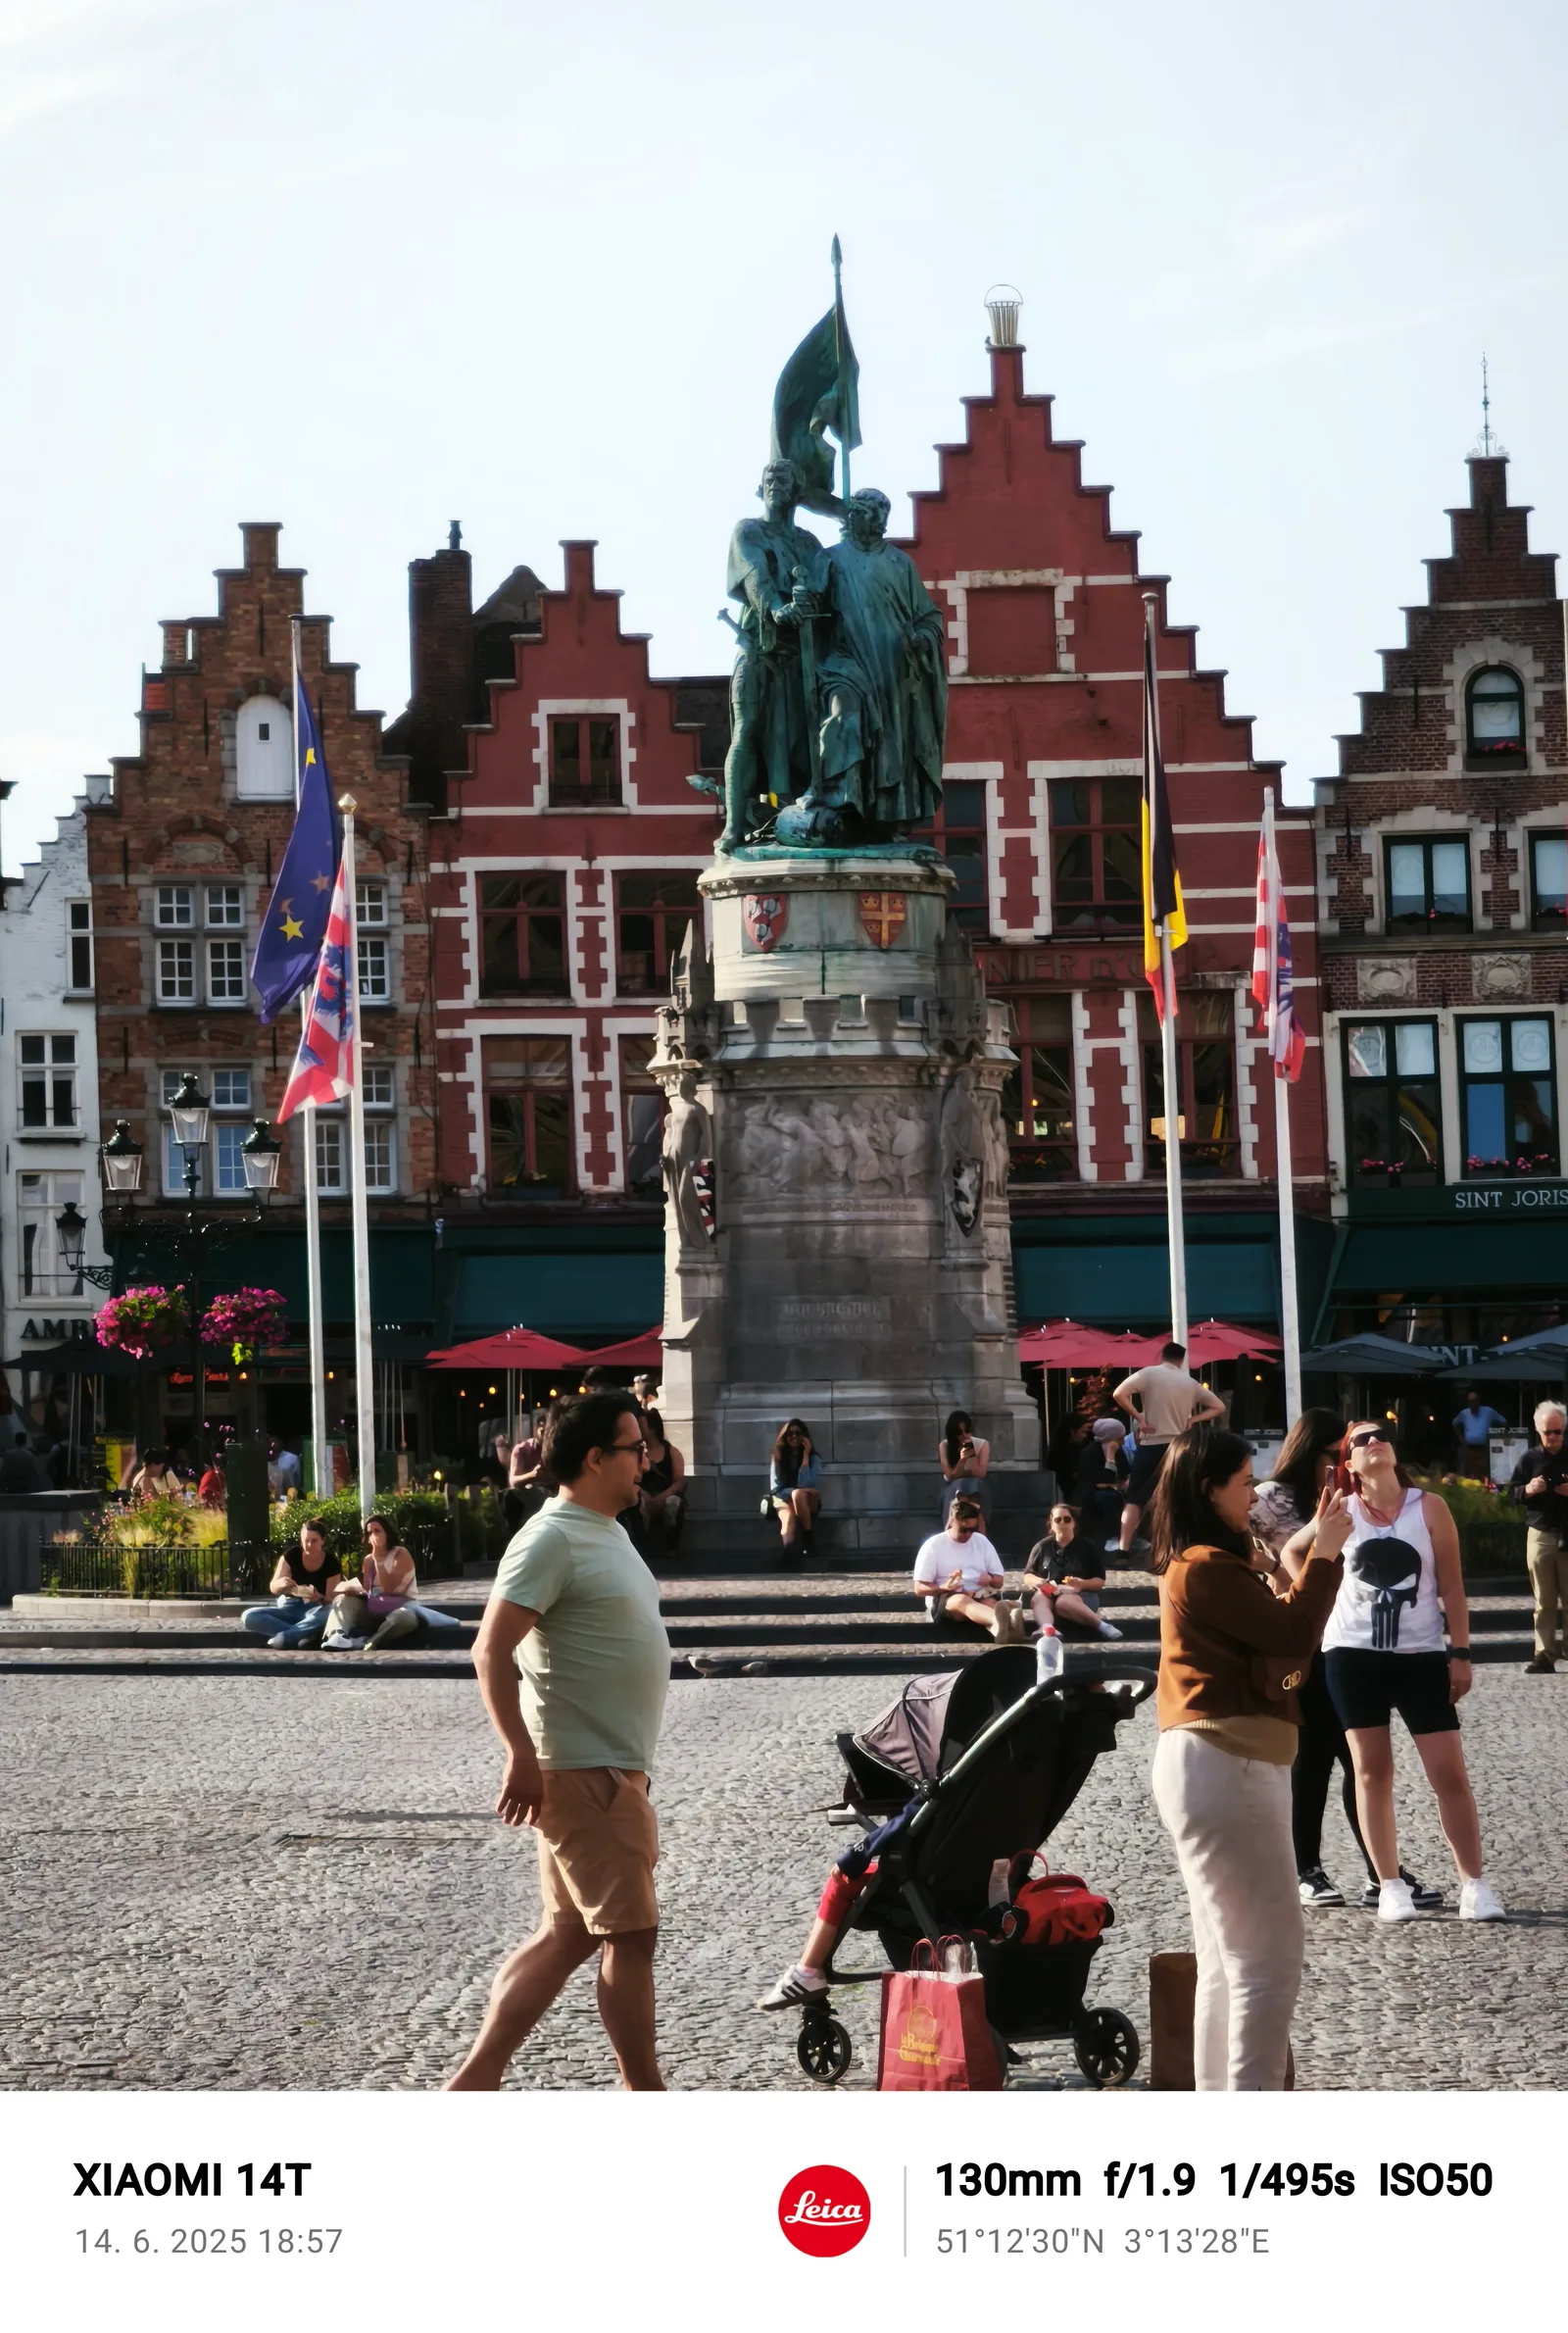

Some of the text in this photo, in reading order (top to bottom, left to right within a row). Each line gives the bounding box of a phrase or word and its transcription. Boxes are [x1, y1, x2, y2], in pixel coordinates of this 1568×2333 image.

[1454, 1189, 1568, 1209] SINT JORIS
[21, 1317, 96, 1341] AMB
